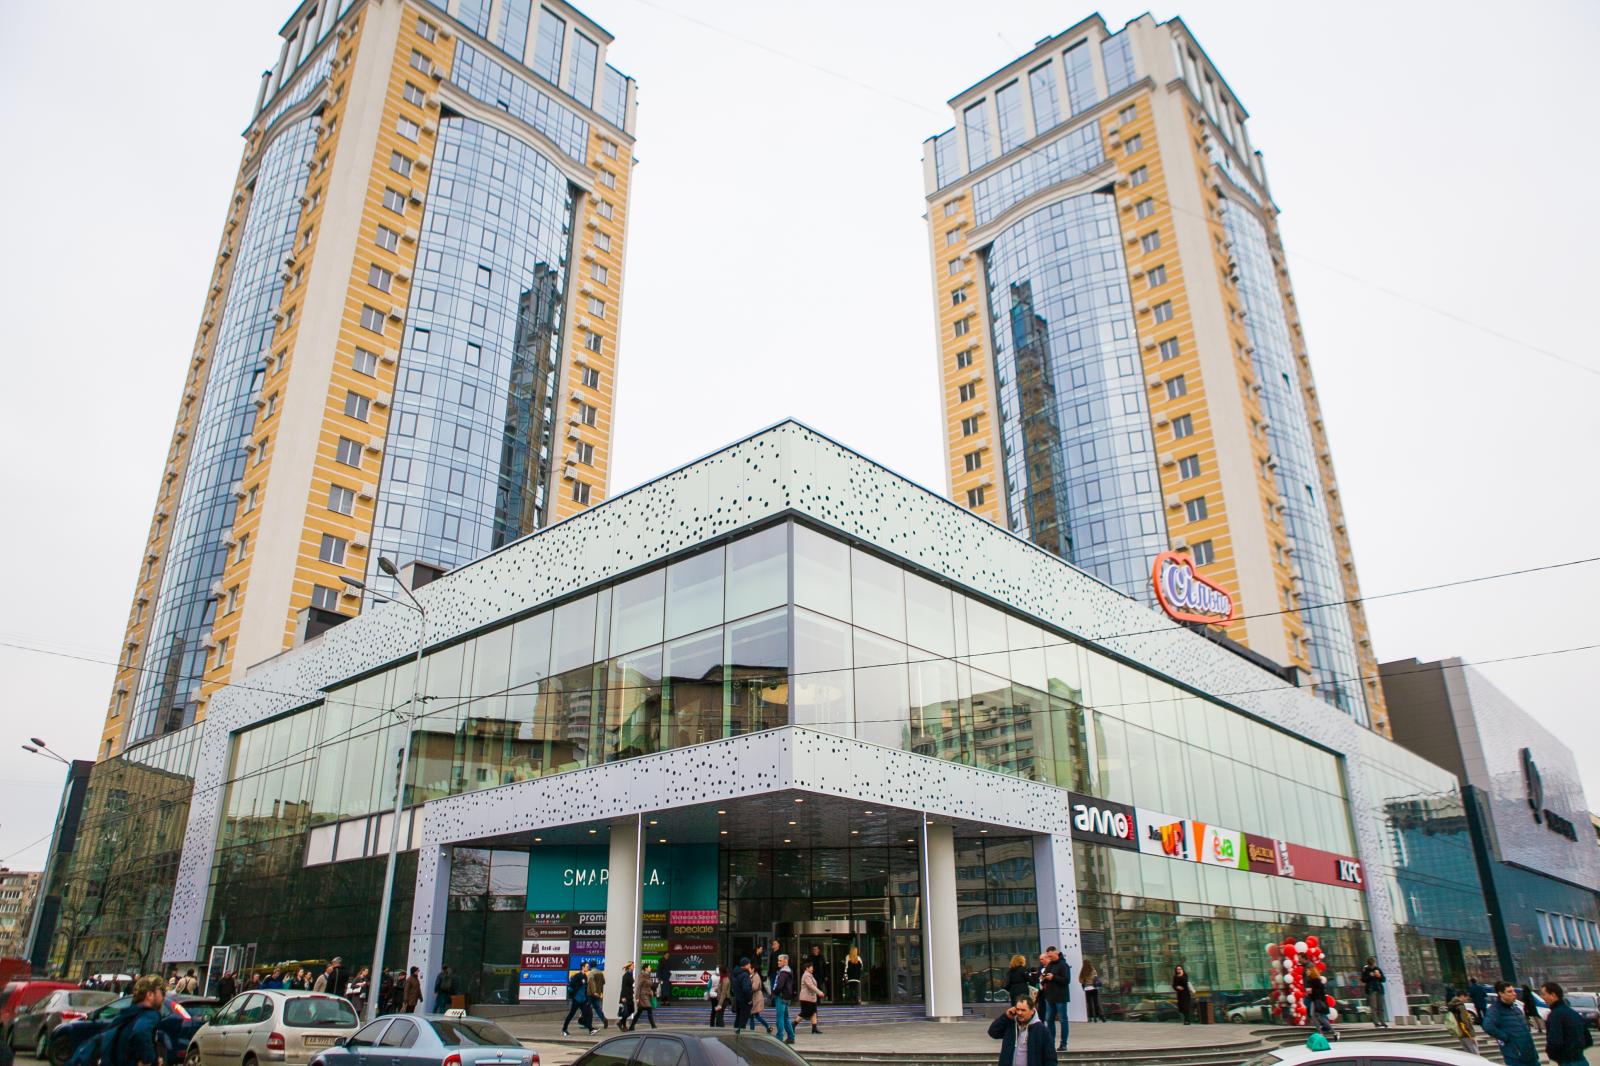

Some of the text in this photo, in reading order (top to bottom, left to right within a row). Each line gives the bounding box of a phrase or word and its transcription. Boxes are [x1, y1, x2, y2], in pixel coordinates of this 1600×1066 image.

[1339, 860, 1363, 884] KFC
[673, 925, 714, 935] speciale
[525, 956, 564, 965] DIADEMA
[528, 986, 558, 996] NOIR
